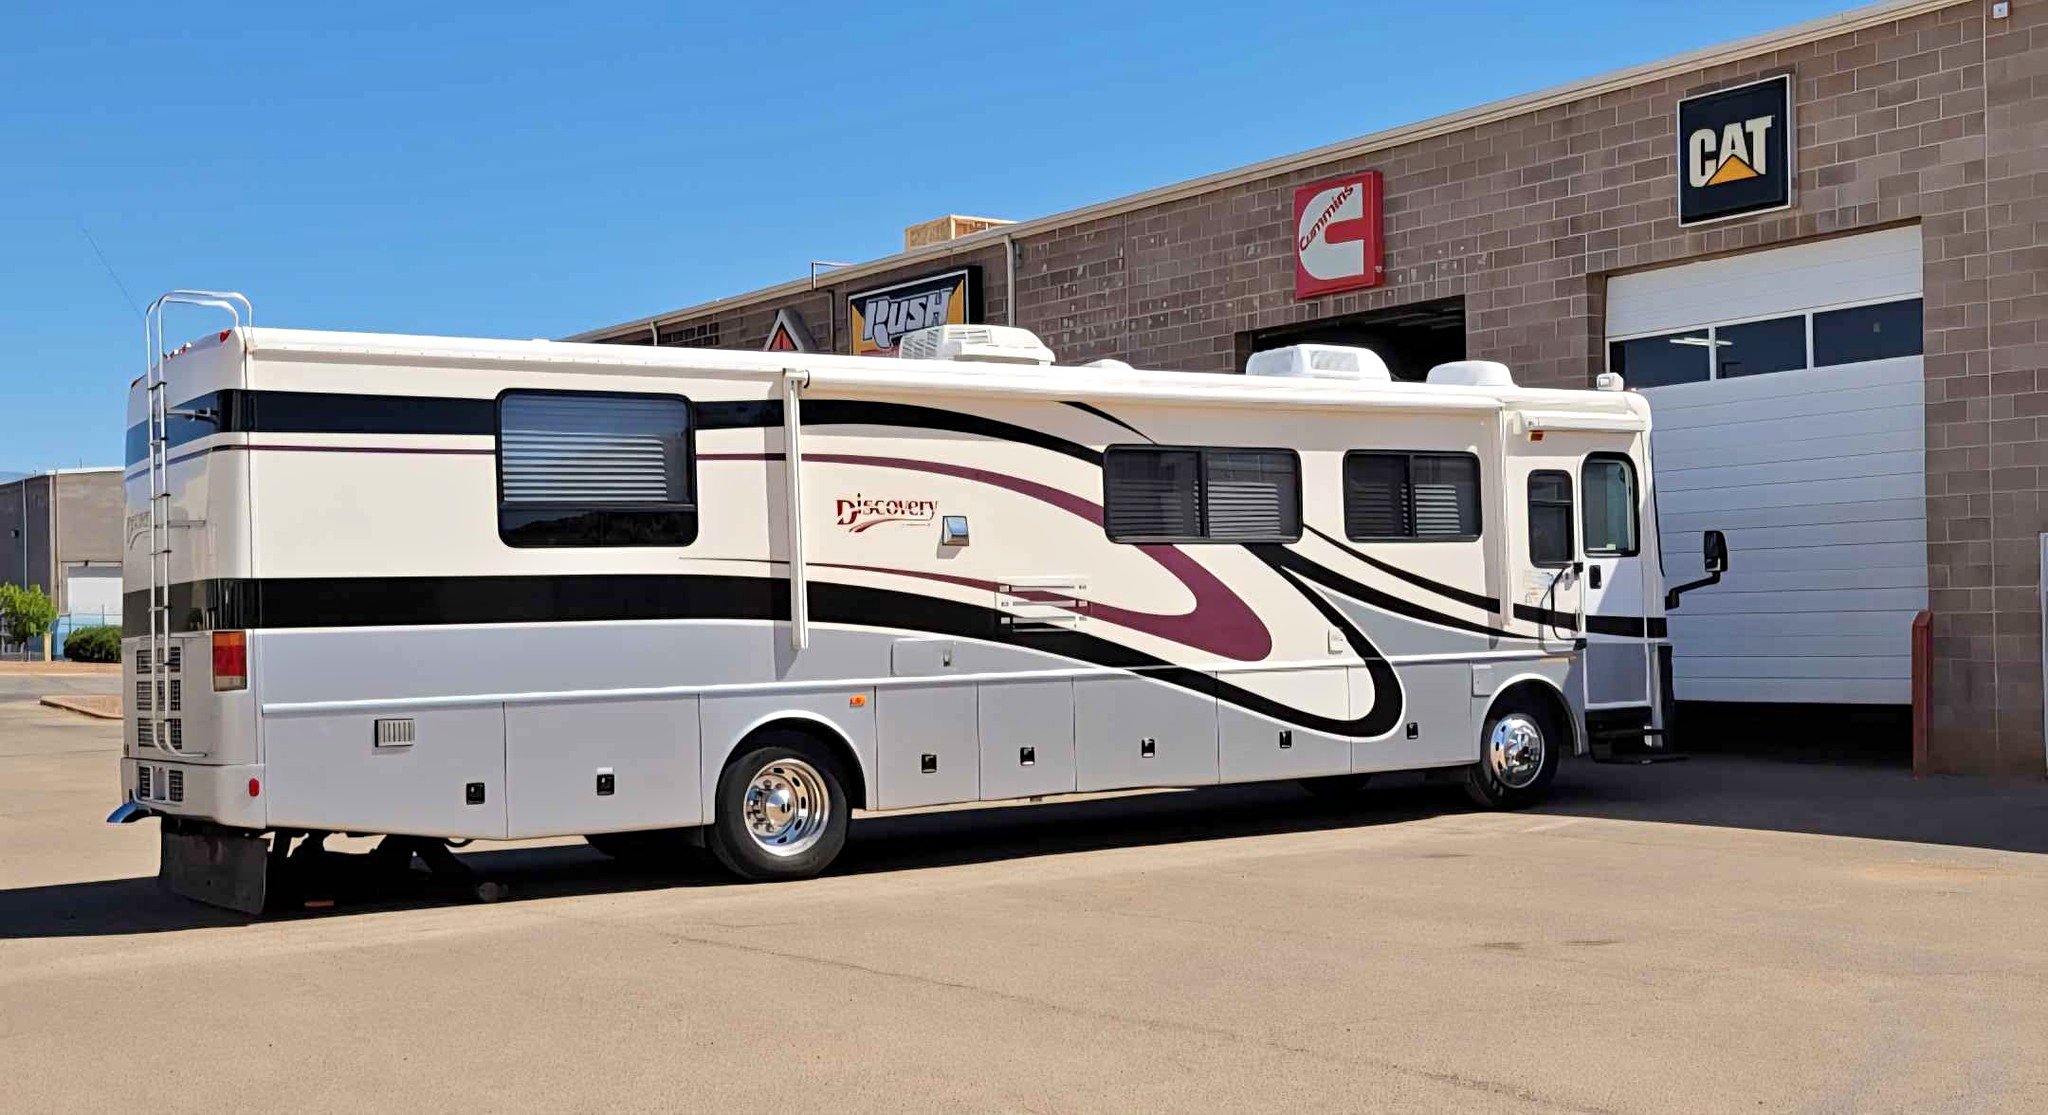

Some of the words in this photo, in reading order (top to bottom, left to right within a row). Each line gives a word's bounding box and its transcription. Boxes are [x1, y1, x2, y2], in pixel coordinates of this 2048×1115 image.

[1689, 115, 1772, 188] CAT
[1299, 185, 1355, 251] Cummins
[863, 287, 953, 348] RUSH
[836, 493, 938, 525] Discovery
